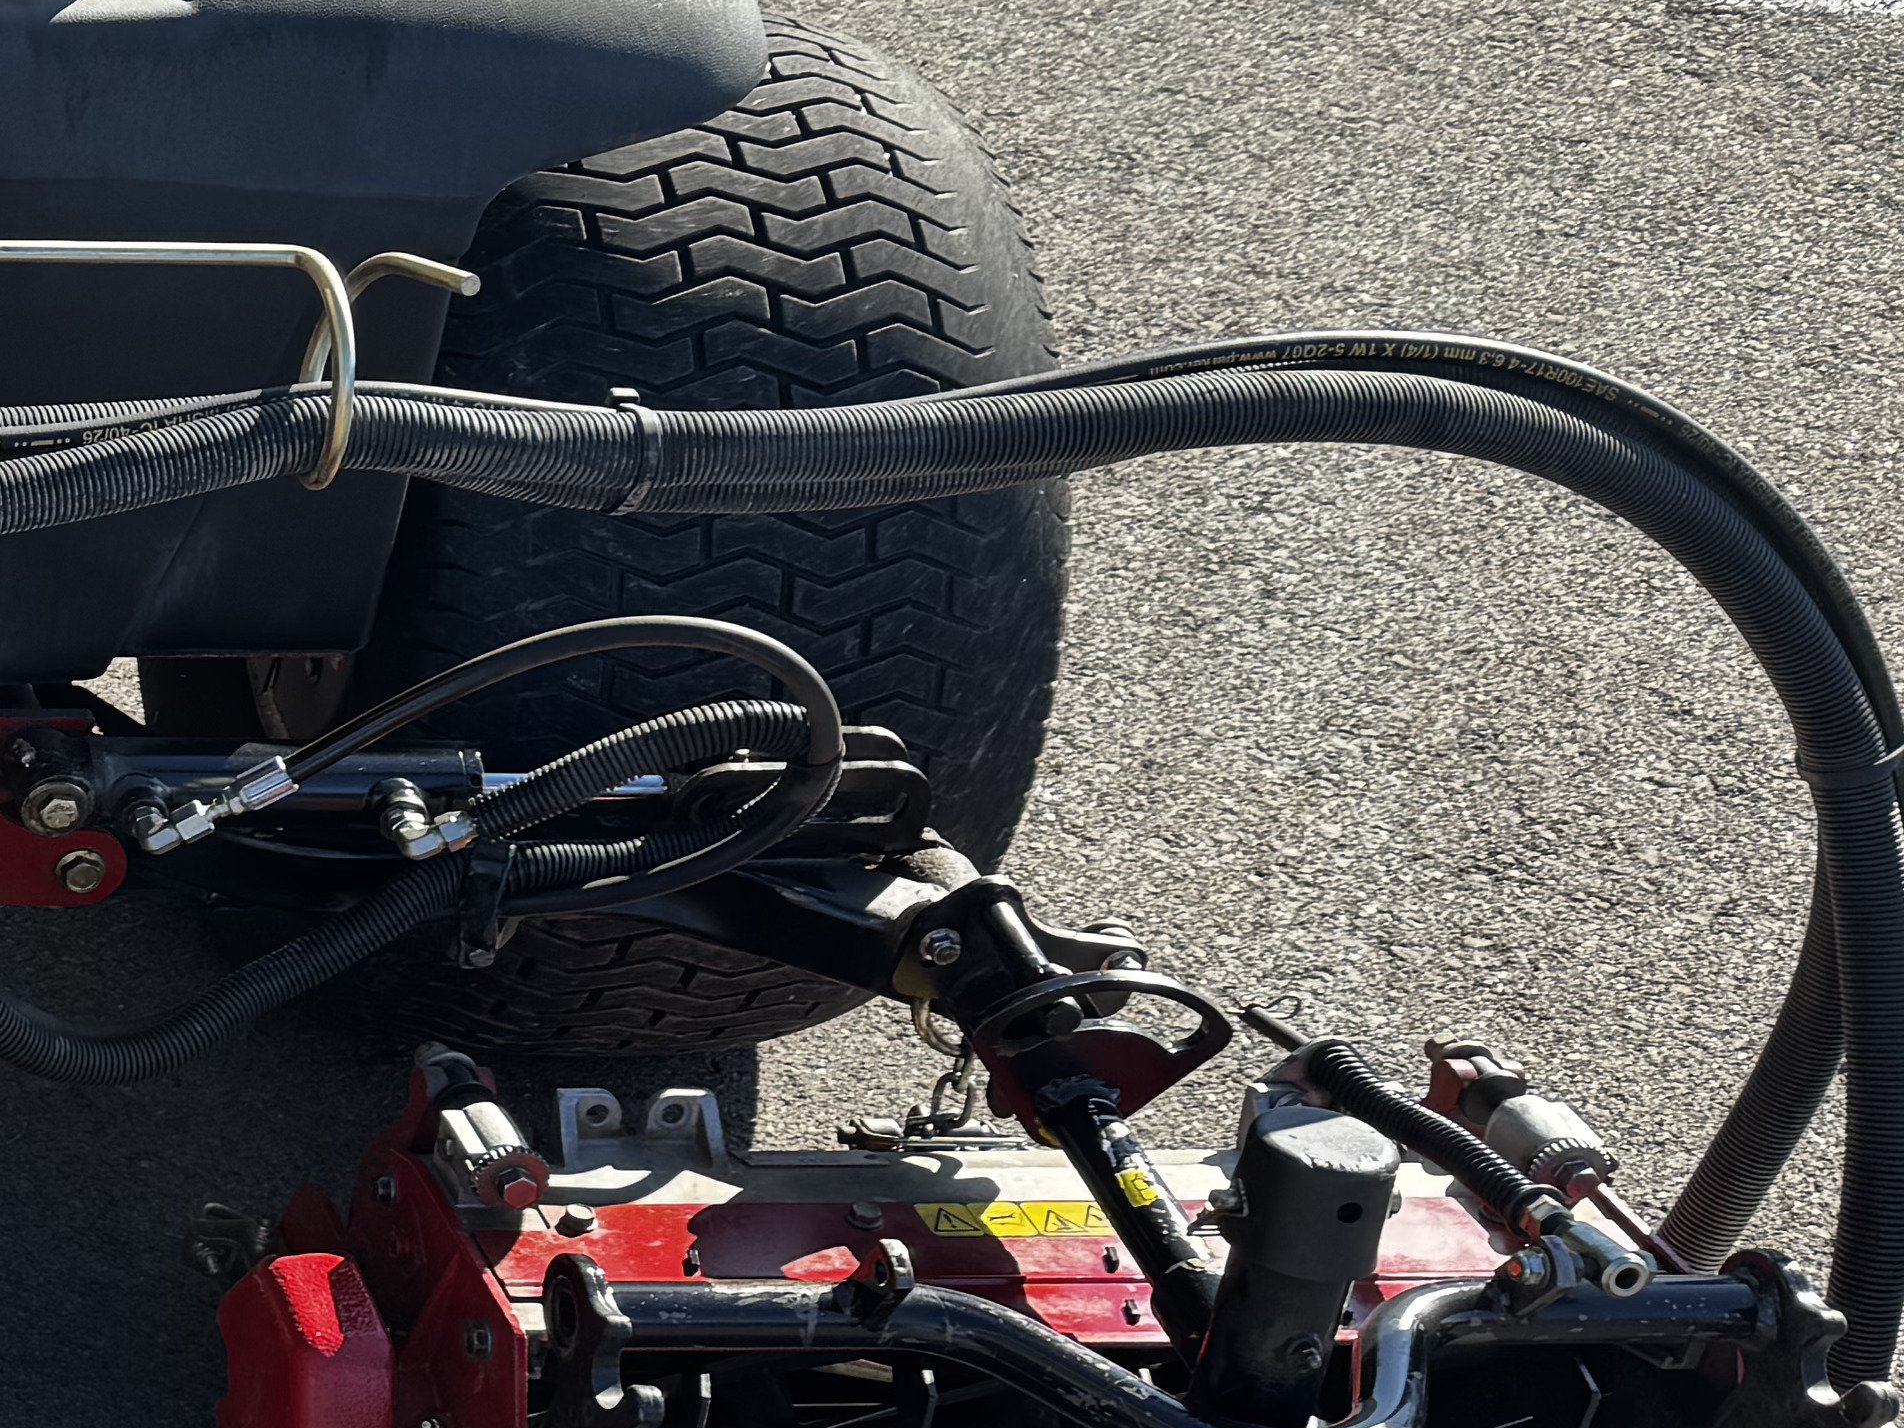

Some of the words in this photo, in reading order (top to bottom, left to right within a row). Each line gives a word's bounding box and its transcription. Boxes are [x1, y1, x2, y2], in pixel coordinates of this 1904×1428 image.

[1349, 342, 1377, 357] 1W
[1382, 342, 1396, 357] X
[1400, 342, 1439, 359] (1/4)
[1444, 346, 1476, 361] mm
[1507, 355, 1620, 402] SAE100R17-4
